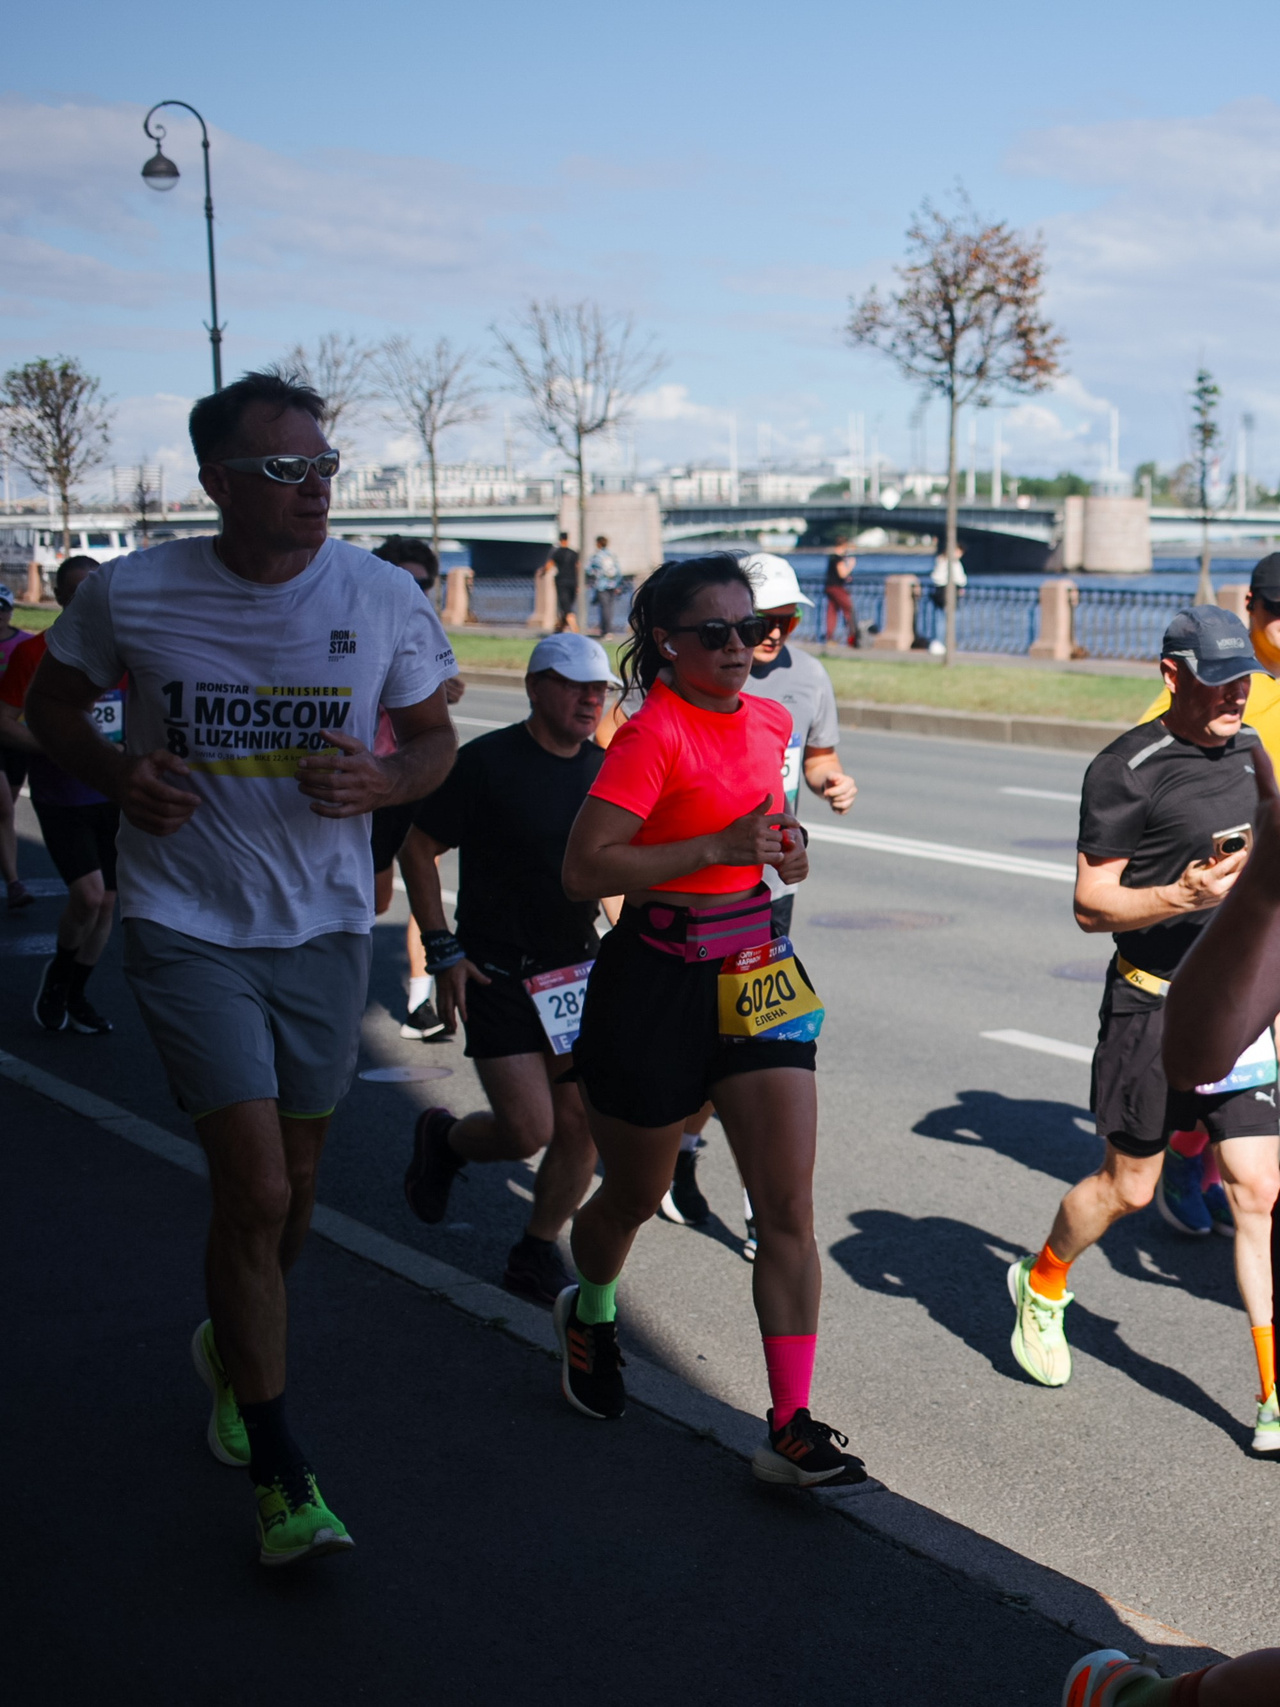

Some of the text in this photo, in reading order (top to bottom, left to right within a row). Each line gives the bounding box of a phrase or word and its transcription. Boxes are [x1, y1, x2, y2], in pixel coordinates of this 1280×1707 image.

[330, 630, 350, 641] IRON
[329, 641, 357, 654] STAR
[161, 680, 184, 719] 1
[196, 682, 340, 697] IRONSTAR FINISHER
[194, 696, 352, 729] MOSCOW
[166, 727, 189, 759] 8
[194, 728, 293, 750] LUZHNIKI
[736, 970, 796, 1017] 6020
[755, 1008, 787, 1027] ЕЛЕНА
[559, 1034, 572, 1049] E
